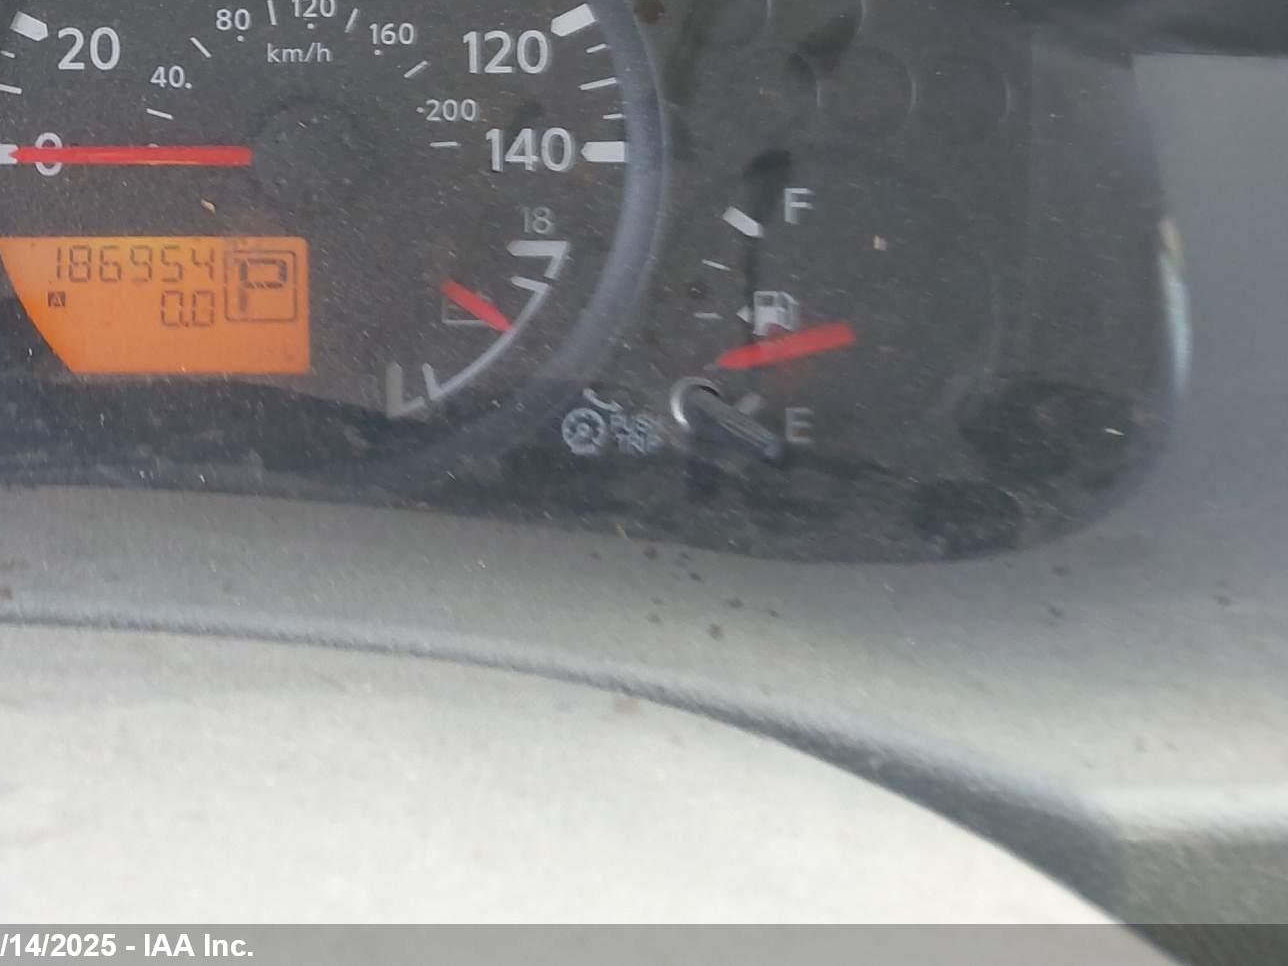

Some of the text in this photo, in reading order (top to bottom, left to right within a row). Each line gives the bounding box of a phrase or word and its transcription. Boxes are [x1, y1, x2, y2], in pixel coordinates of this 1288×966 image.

[216, 7, 251, 31] 80
[370, 22, 415, 45] 160
[57, 26, 121, 71] 20
[266, 42, 332, 64] km/h
[463, 30, 550, 75] 120
[425, 98, 478, 122] 200
[35, 132, 64, 176] 0
[485, 127, 573, 172] 140
[522, 206, 555, 233] 18
[784, 188, 813, 224] F
[56, 244, 215, 283] 186954
[237, 257, 288, 314] P
[160, 289, 215, 328] 0.0
[785, 407, 813, 444] E
